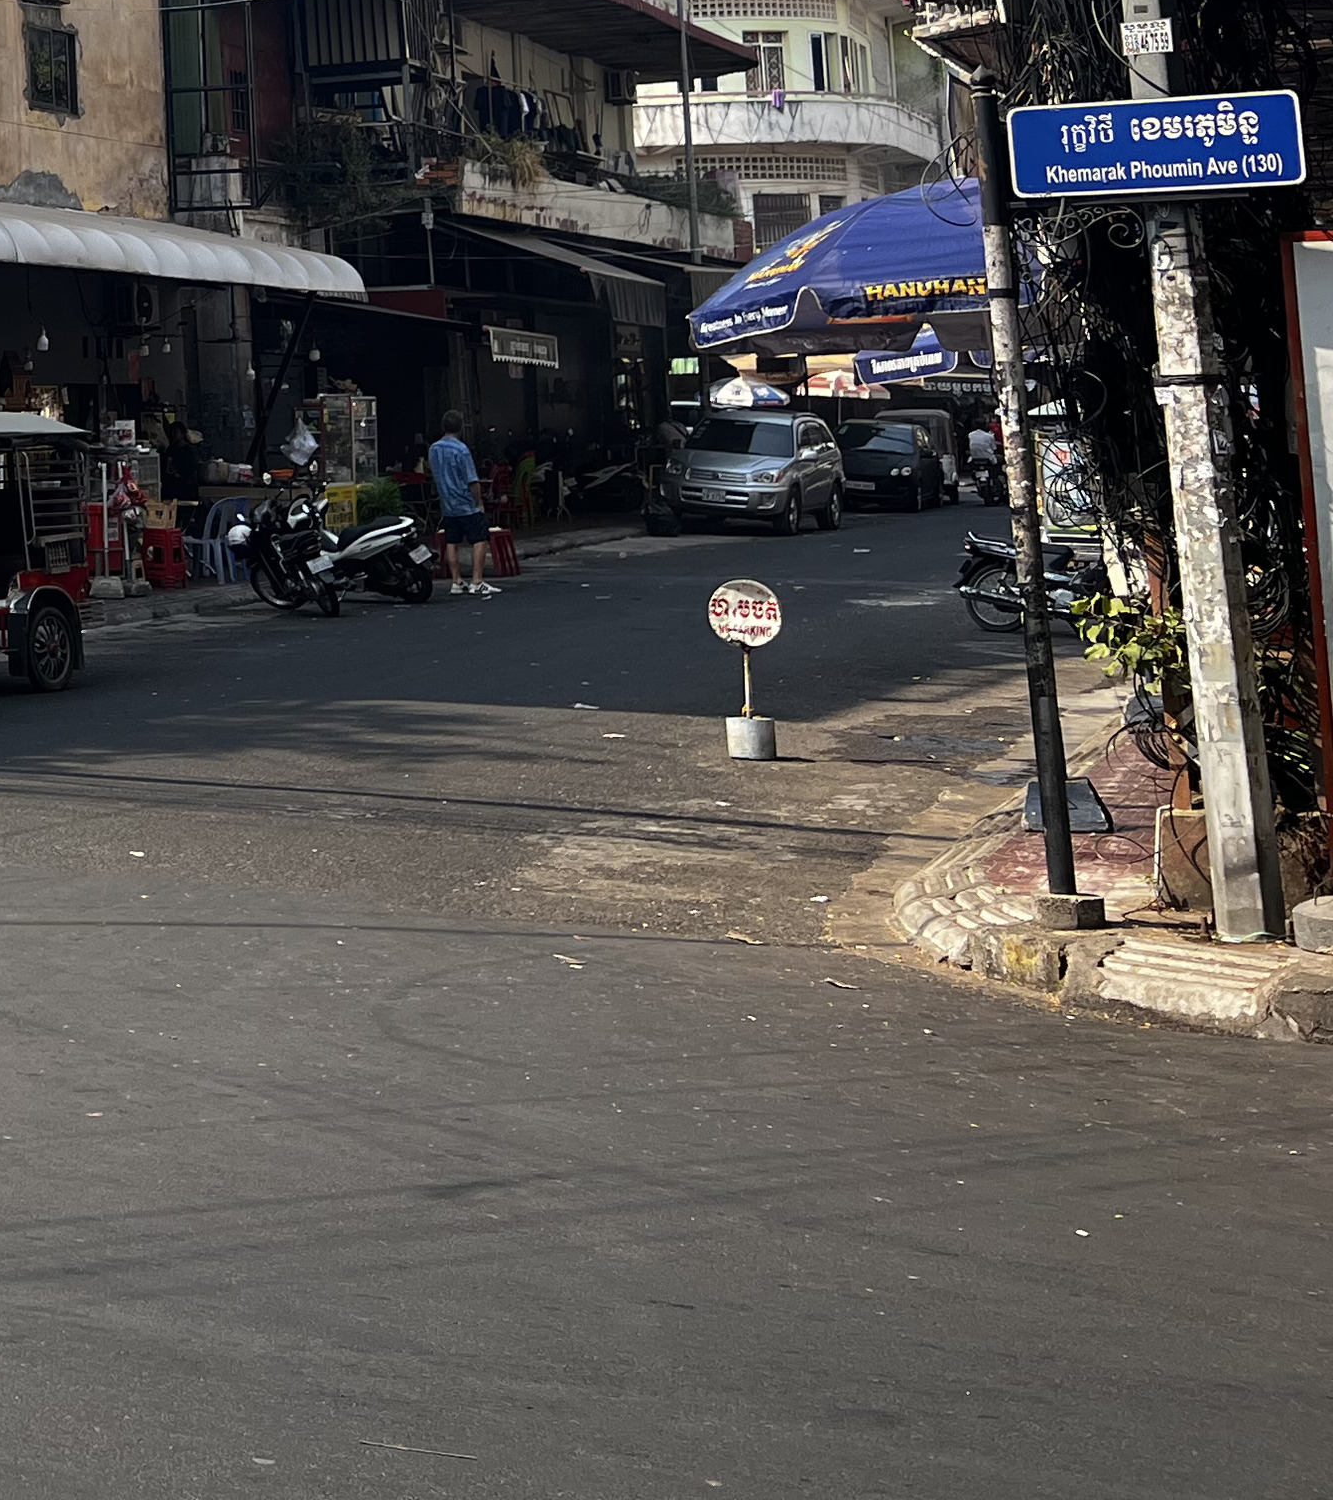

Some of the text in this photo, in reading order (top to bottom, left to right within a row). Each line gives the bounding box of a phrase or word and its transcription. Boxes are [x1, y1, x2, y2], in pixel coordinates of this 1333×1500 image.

[1045, 152, 1284, 184] Khemarak Phoumin Ave (130)
[865, 278, 987, 302] HANUMAN
